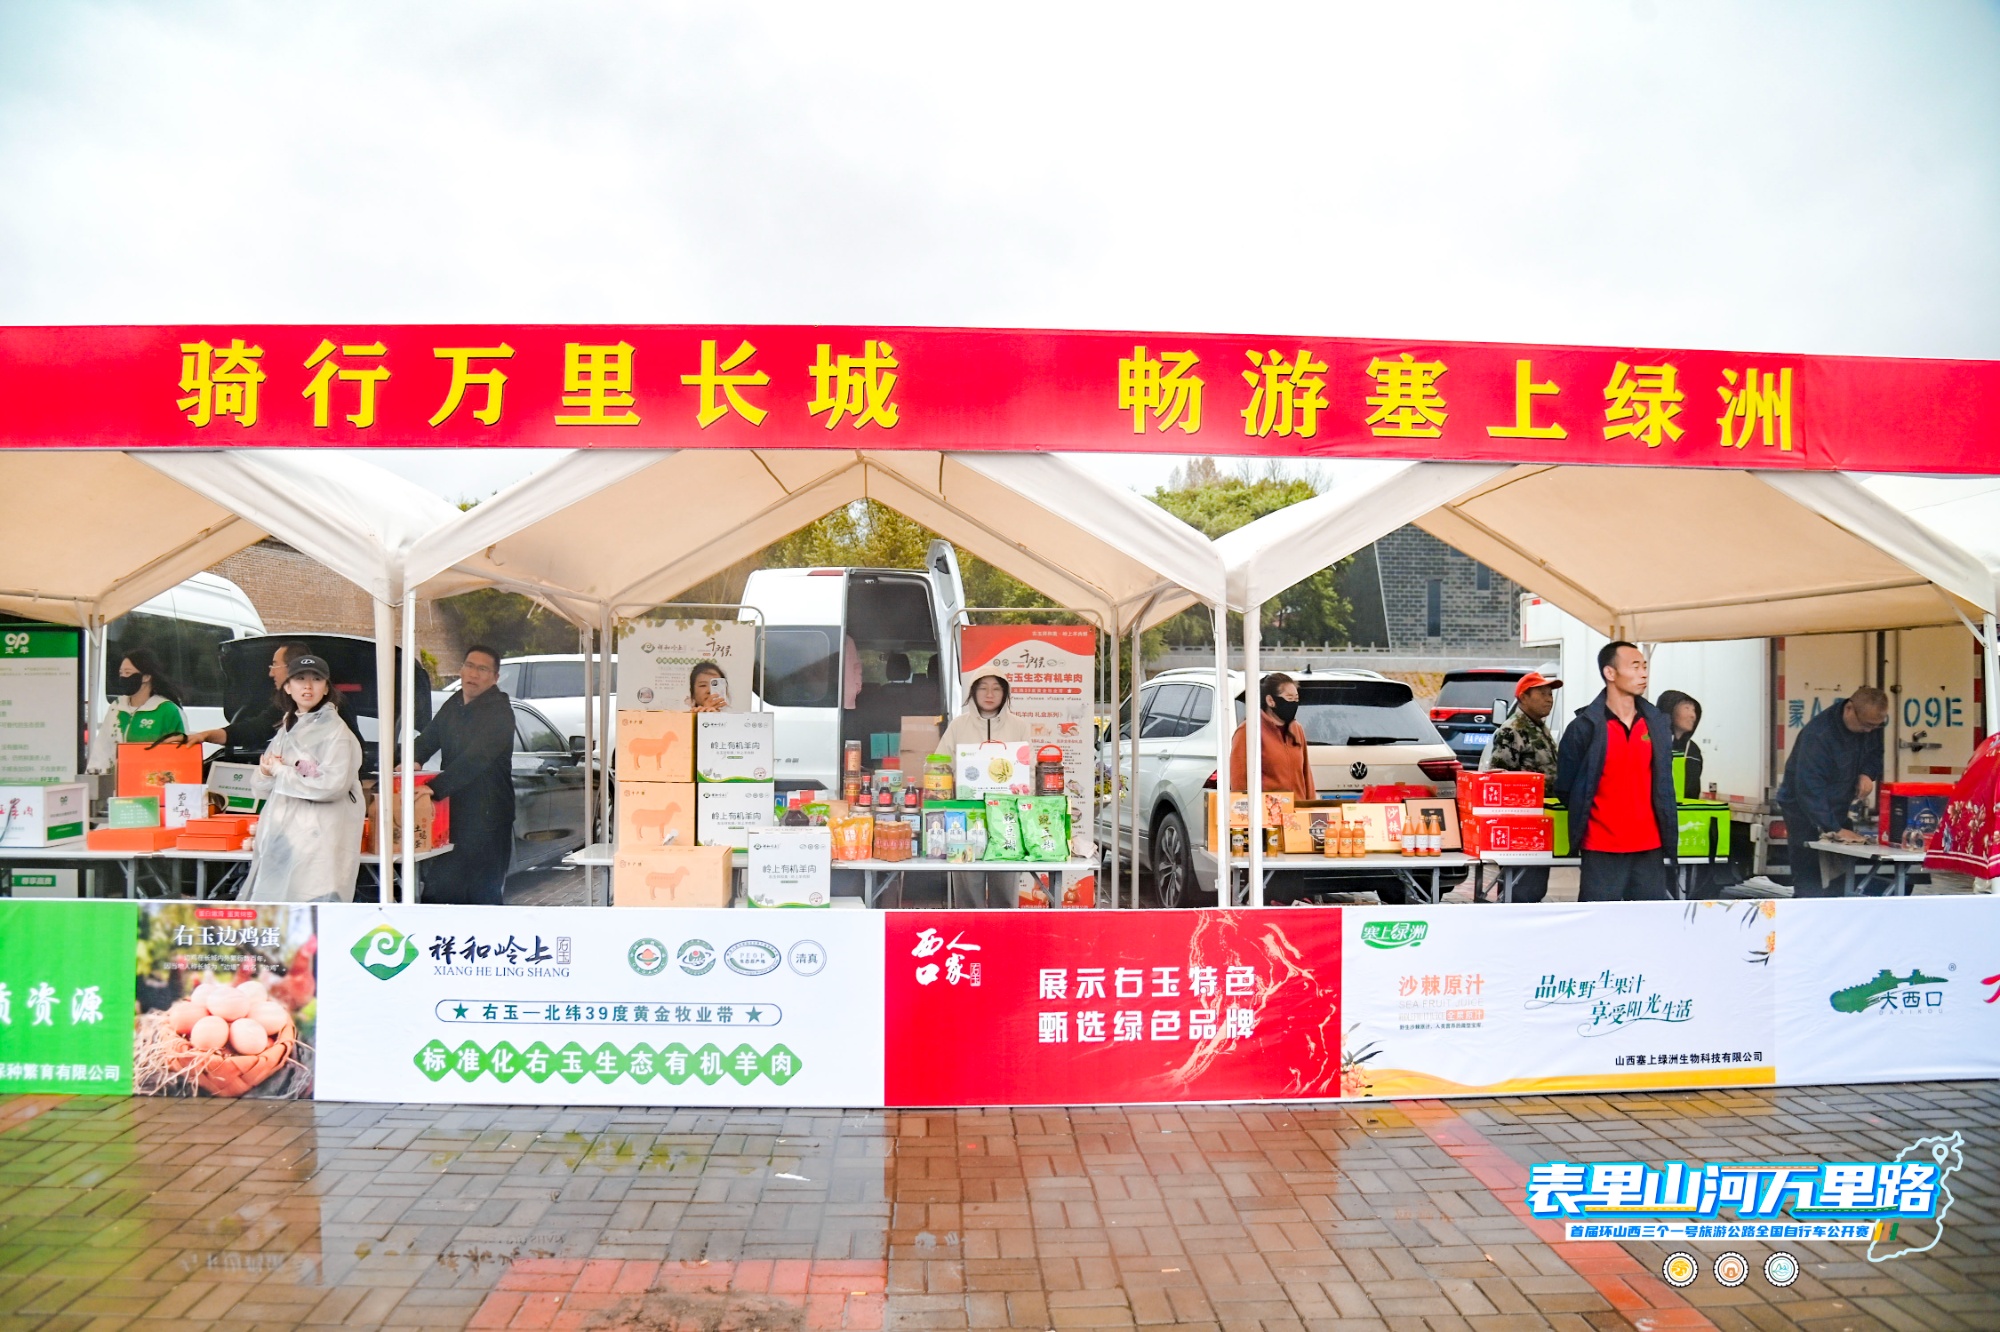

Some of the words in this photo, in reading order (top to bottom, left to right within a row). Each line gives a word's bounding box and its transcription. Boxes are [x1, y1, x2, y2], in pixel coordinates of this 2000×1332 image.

[177, 340, 900, 428] 骑行万里长城
[1118, 346, 1794, 451] 畅游塞上绿洲
[173, 925, 281, 948] 右玉边鸡蛋
[1362, 921, 1427, 940] 塞上绿洲
[429, 935, 553, 965] 祥和岭上
[796, 953, 818, 964] 清真
[434, 966, 473, 976] XIANG
[476, 967, 492, 977] HE
[496, 967, 524, 977] LING
[527, 967, 570, 978] SHANG
[1038, 966, 1255, 999] 展示右玉特色
[1398, 973, 1485, 997] 沙棘原汁
[1534, 969, 1646, 999] 品味野生果汁
[1399, 1000, 1419, 1010] SEA
[1422, 999, 1451, 1009] FRUIT
[1455, 998, 1484, 1008] JUICE
[1586, 993, 1693, 1026] 享受阳光生活
[1879, 991, 1943, 1010] 大西口
[1038, 1009, 1255, 1043] 甄选绿色品牌
[422, 1047, 792, 1076] 标准化右玉生态有机羊肉
[1615, 1051, 1763, 1067] 山西塞上绿洲生物科技有限公司
